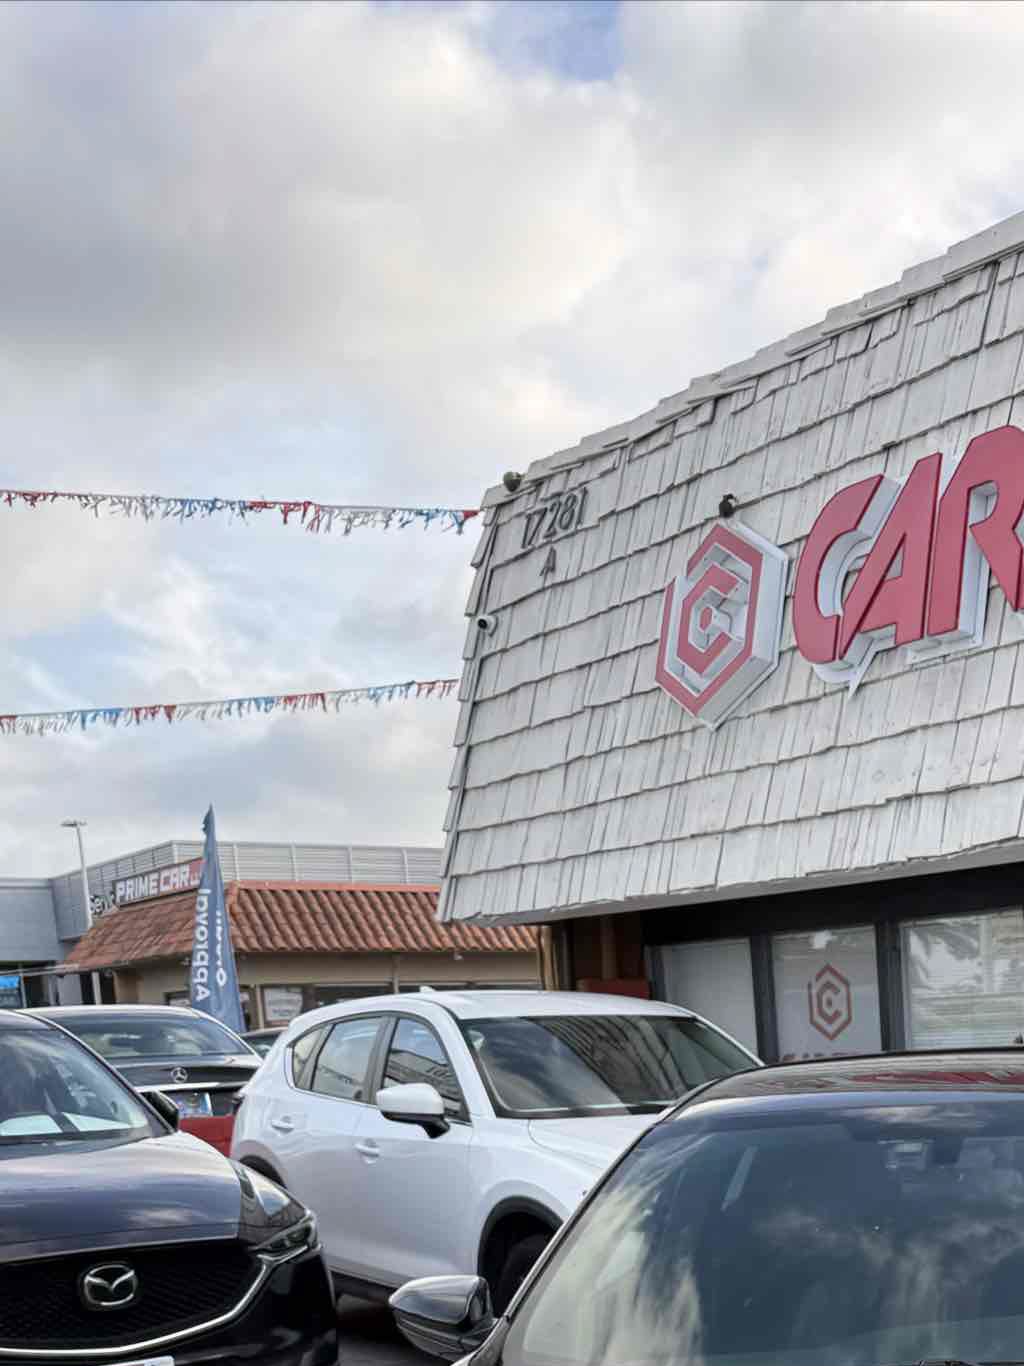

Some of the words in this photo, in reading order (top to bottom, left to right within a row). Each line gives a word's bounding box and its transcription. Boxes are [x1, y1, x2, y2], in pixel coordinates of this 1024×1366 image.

[521, 487, 588, 548] 17281
[116, 871, 159, 903] PRIME
[160, 863, 190, 891] CAR
